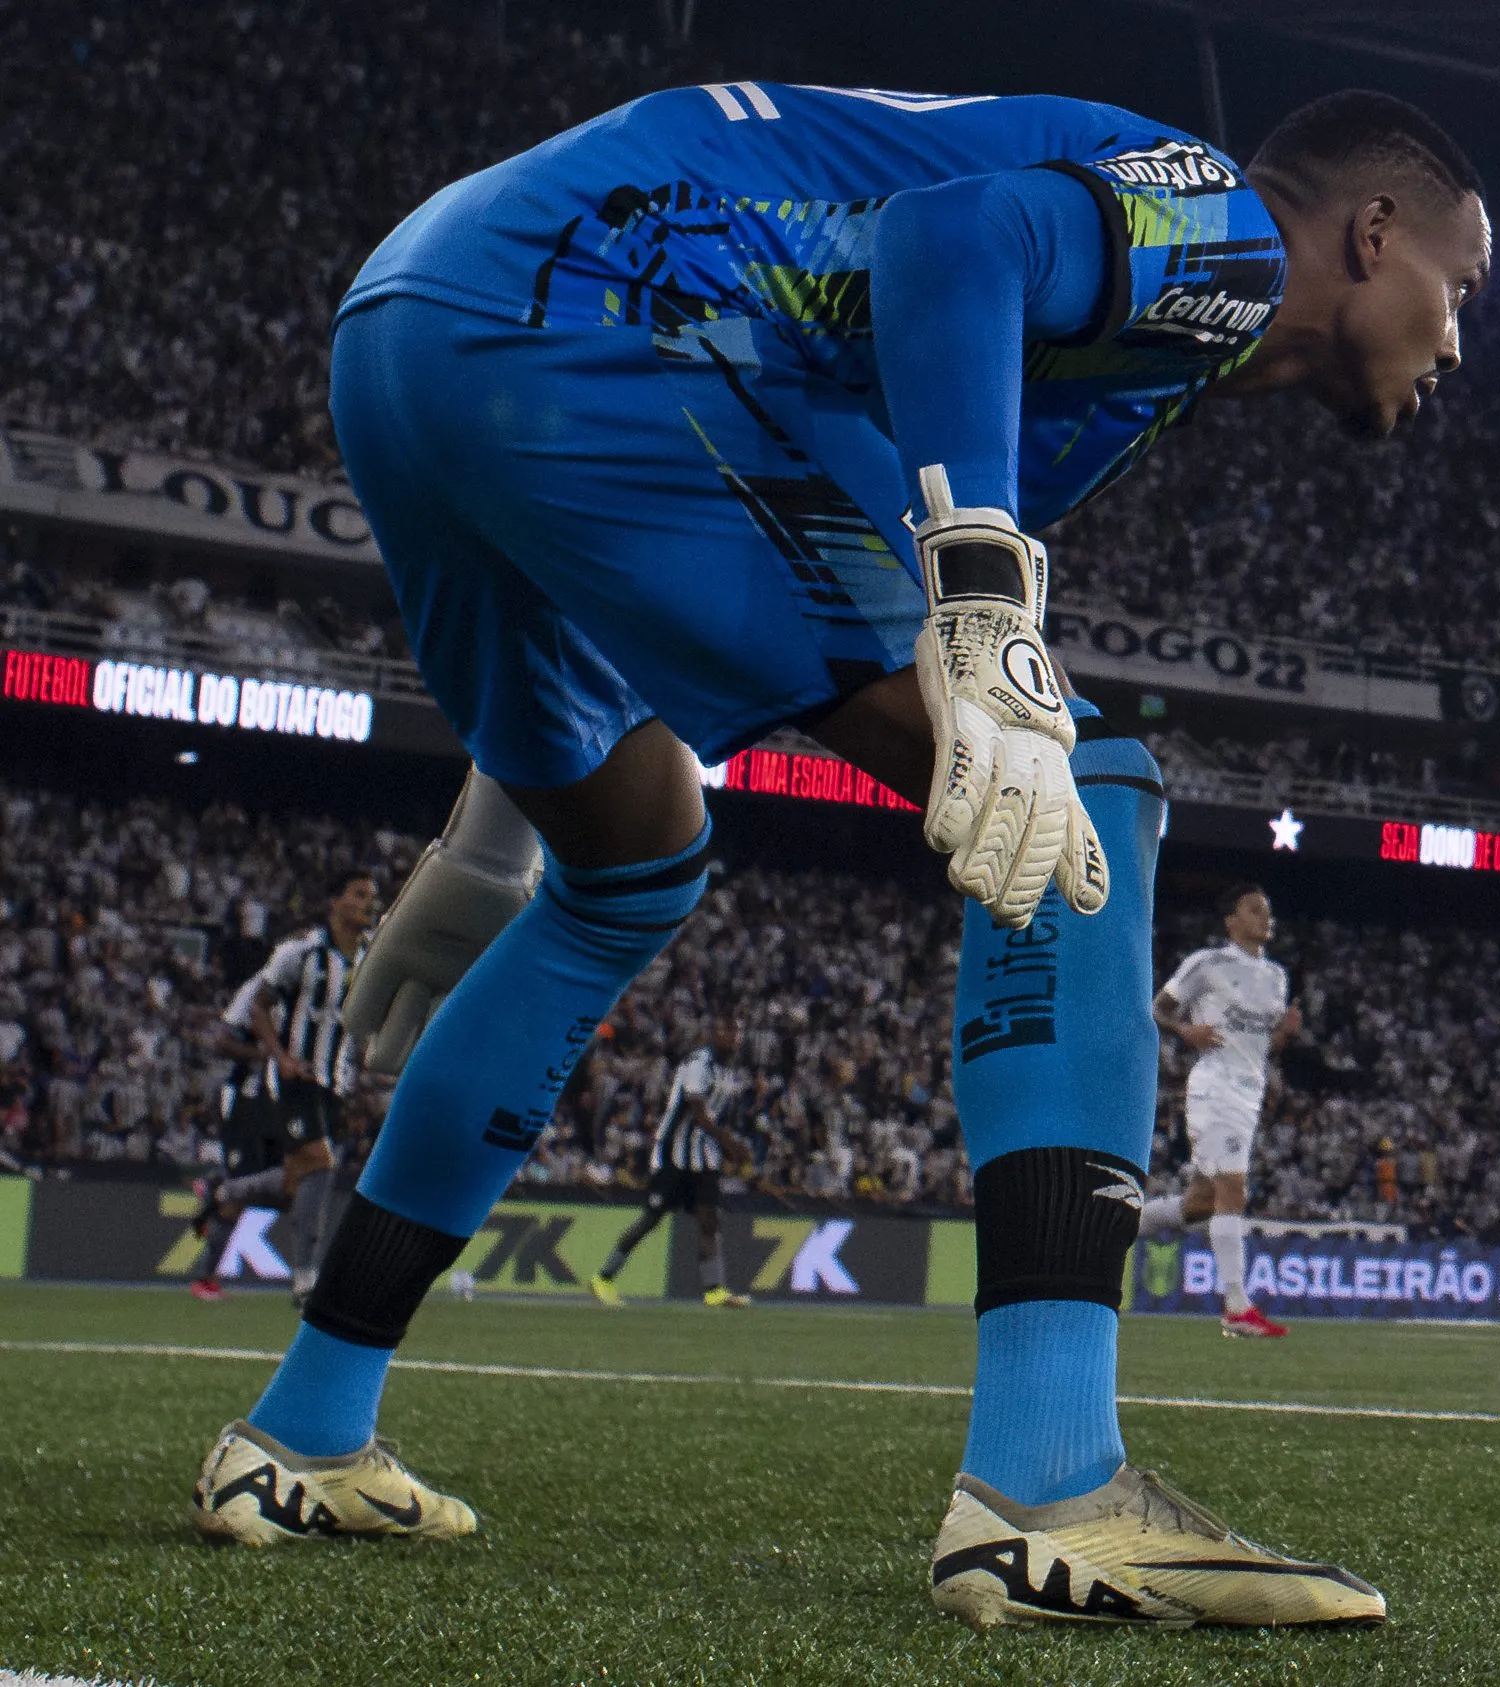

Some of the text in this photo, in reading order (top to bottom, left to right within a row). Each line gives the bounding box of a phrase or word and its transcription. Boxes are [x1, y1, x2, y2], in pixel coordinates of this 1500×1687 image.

[1147, 287, 1271, 331] Centrum
[93, 660, 195, 721] OFICIAL
[198, 673, 238, 726] DO
[239, 679, 372, 742] BOTAFOGO
[751, 750, 788, 795] UMA
[790, 757, 853, 803] ESCOLA
[1381, 821, 1419, 862] SEJA
[1420, 824, 1476, 868] DONO
[1474, 832, 1492, 869] DE
[472, 1215, 579, 1285] 7K
[752, 1217, 860, 1293] 7K
[1184, 1247, 1492, 1302] BASILEIRÃO
